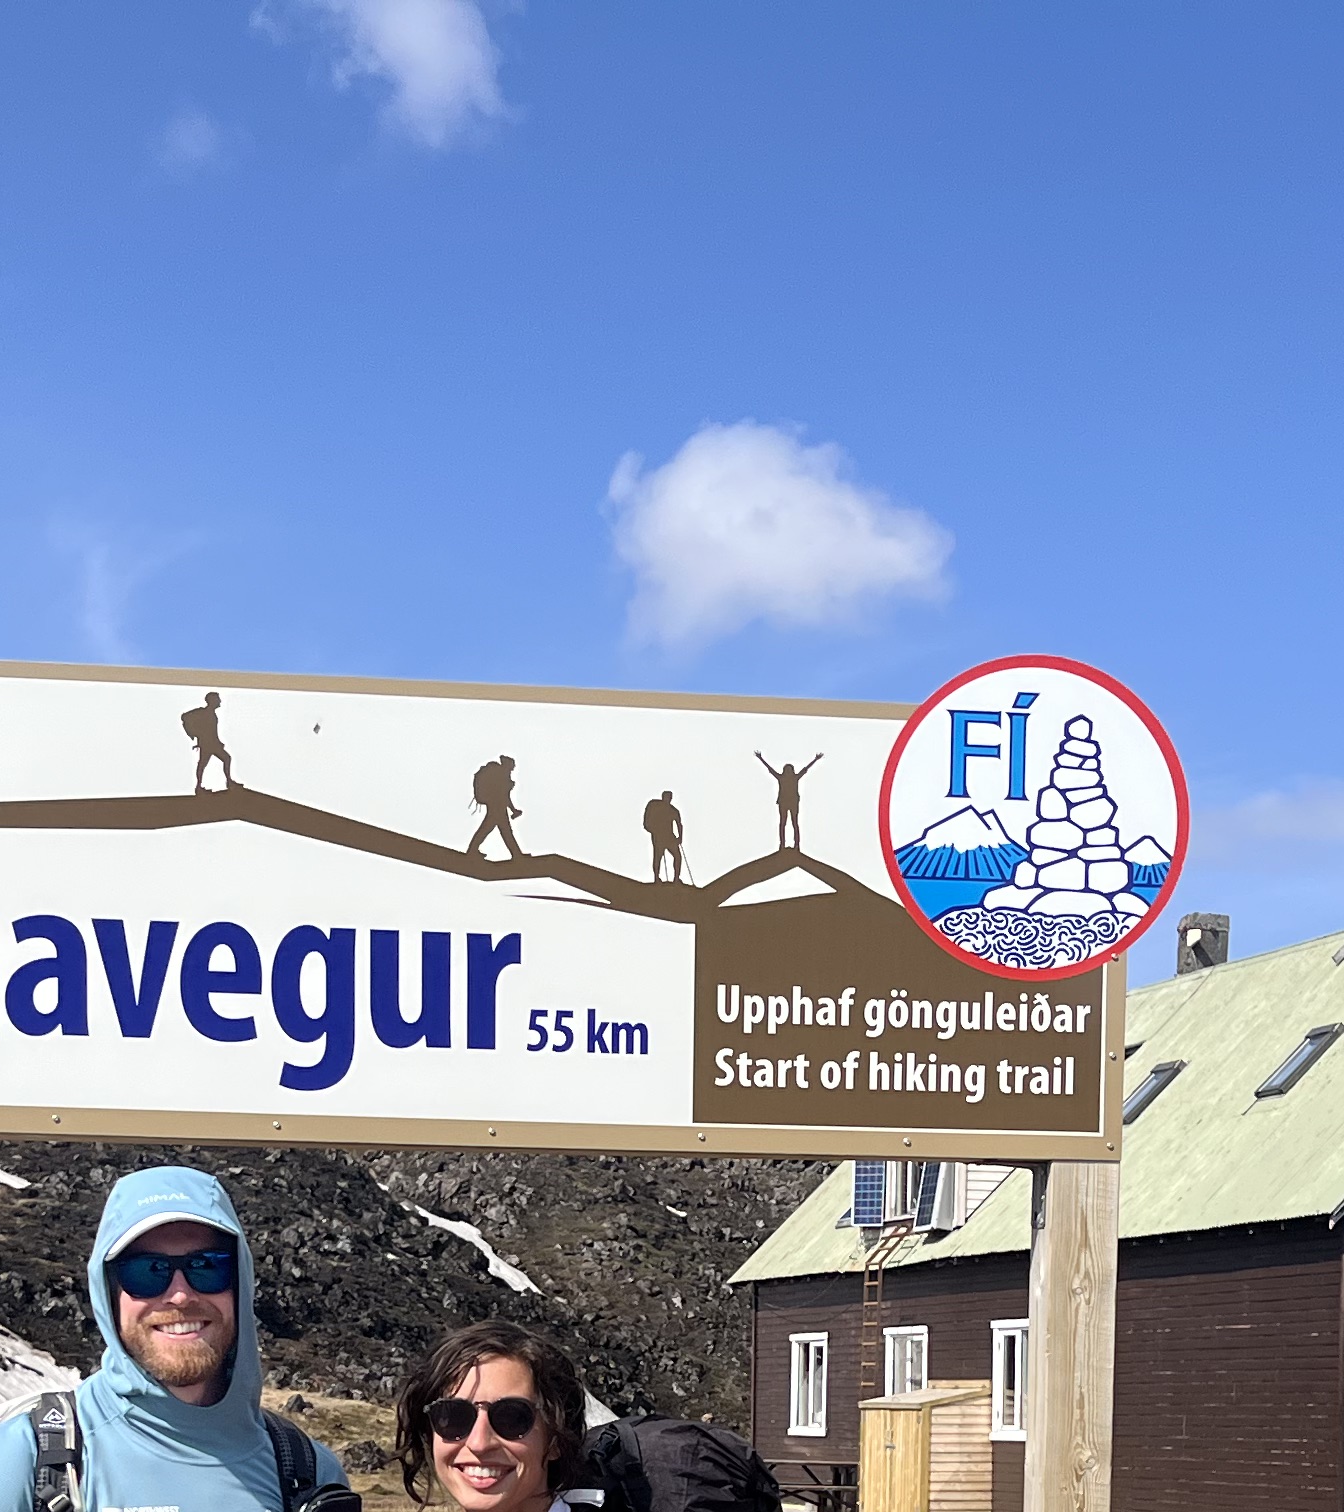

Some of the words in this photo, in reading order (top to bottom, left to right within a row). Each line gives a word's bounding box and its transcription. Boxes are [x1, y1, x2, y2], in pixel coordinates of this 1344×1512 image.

[944, 691, 1041, 802] FÍ
[527, 1008, 575, 1054] 55
[587, 1007, 650, 1056] km
[716, 983, 856, 1036] Upphaf
[862, 987, 1092, 1041] gönguleiðar
[713, 1046, 810, 1090] Start
[819, 1049, 862, 1091] of
[868, 1050, 987, 1104] hiking
[995, 1055, 1076, 1096] trail
